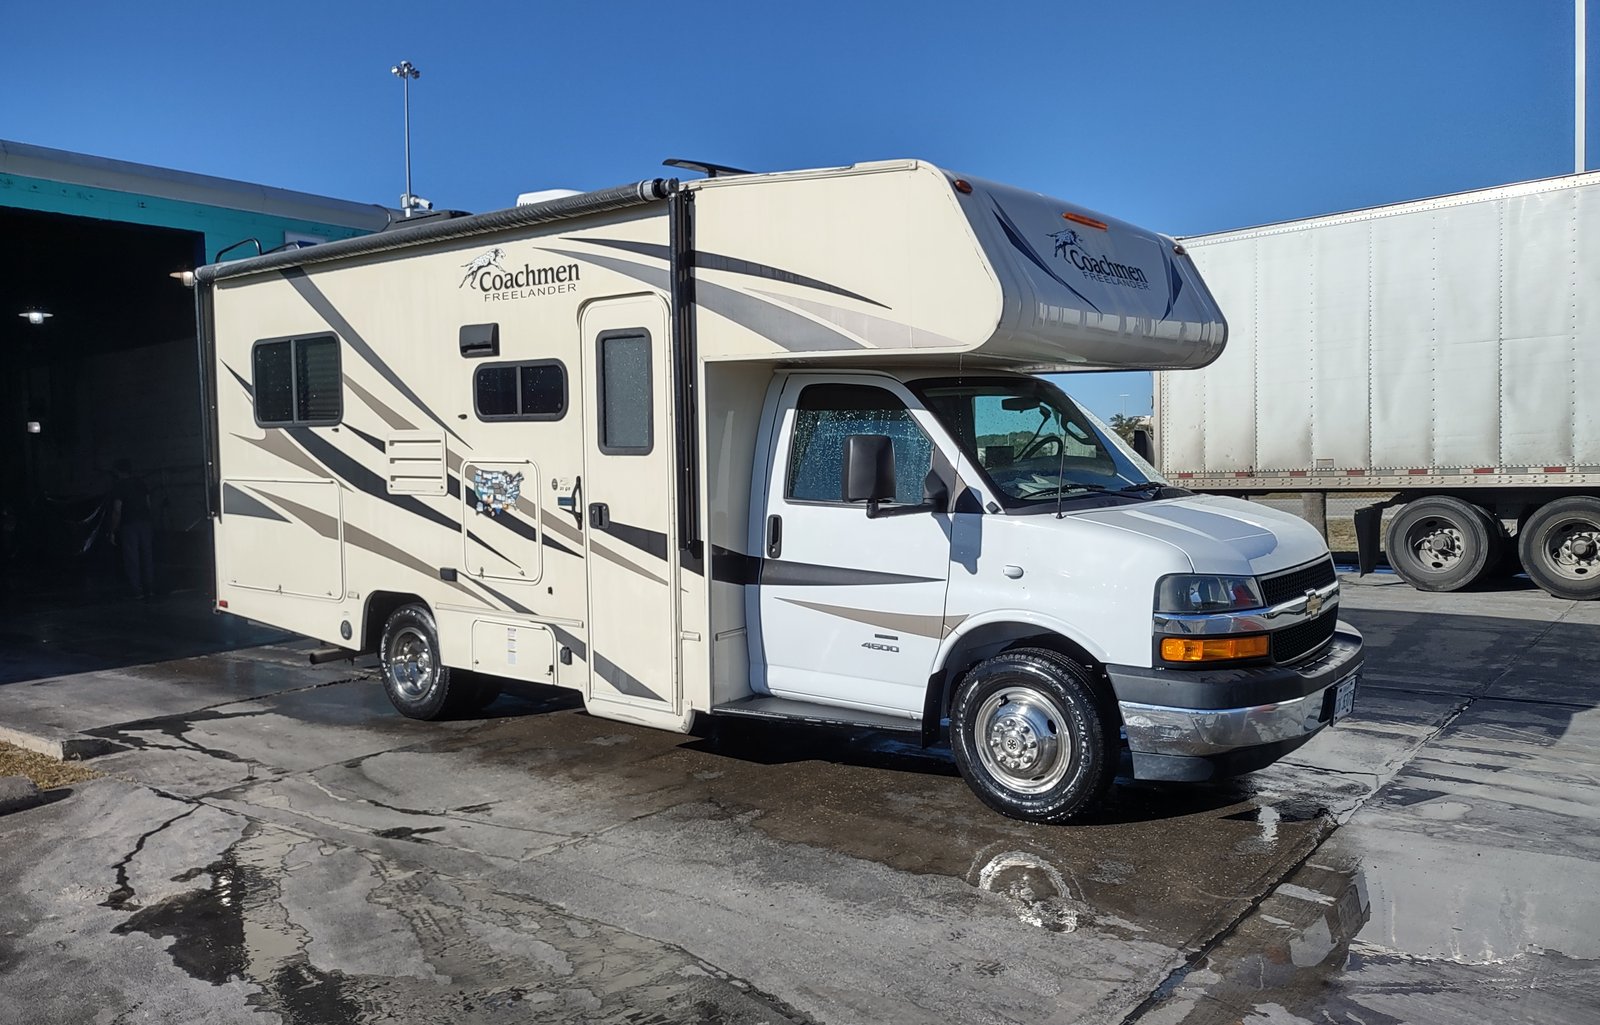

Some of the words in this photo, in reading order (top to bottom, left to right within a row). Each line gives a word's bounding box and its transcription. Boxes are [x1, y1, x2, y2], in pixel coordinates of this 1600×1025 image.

[1070, 249, 1148, 283] Coachmen
[480, 264, 580, 292] Coachmen
[1082, 271, 1151, 290] FREELANDER
[484, 283, 577, 302] FREELANDER
